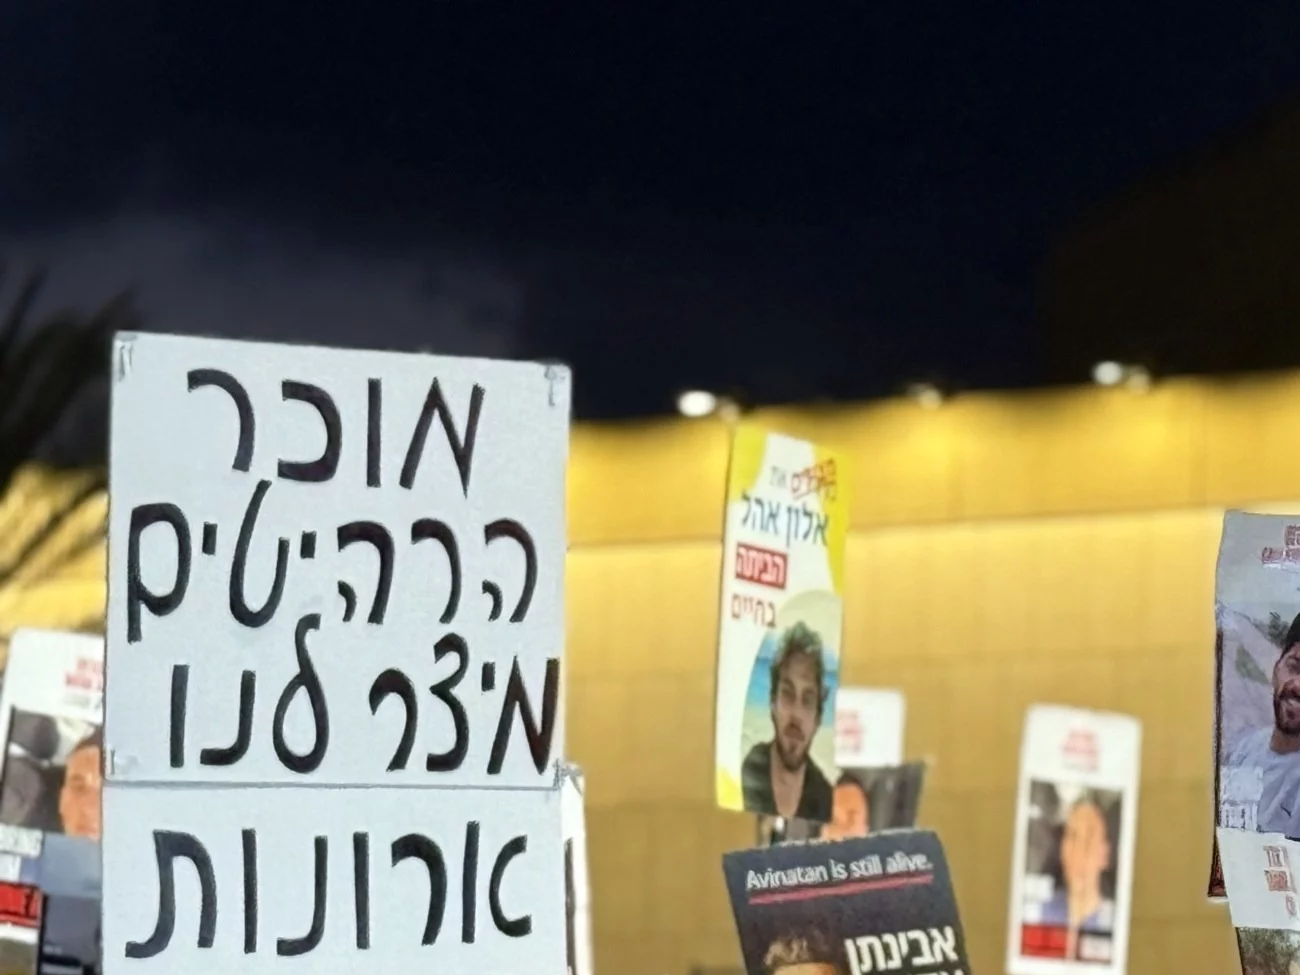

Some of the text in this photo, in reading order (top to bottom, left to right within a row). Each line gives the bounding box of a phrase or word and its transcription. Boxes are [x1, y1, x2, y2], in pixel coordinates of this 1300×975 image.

[187, 367, 486, 498] מוכר
[127, 479, 538, 644] הרהיטים
[786, 501, 829, 549] אלון
[170, 613, 561, 775] מיצר לנו
[125, 820, 531, 959] ארונות
[746, 865, 829, 890] Avinatan
[828, 859, 849, 880] is
[849, 854, 883, 878] still
